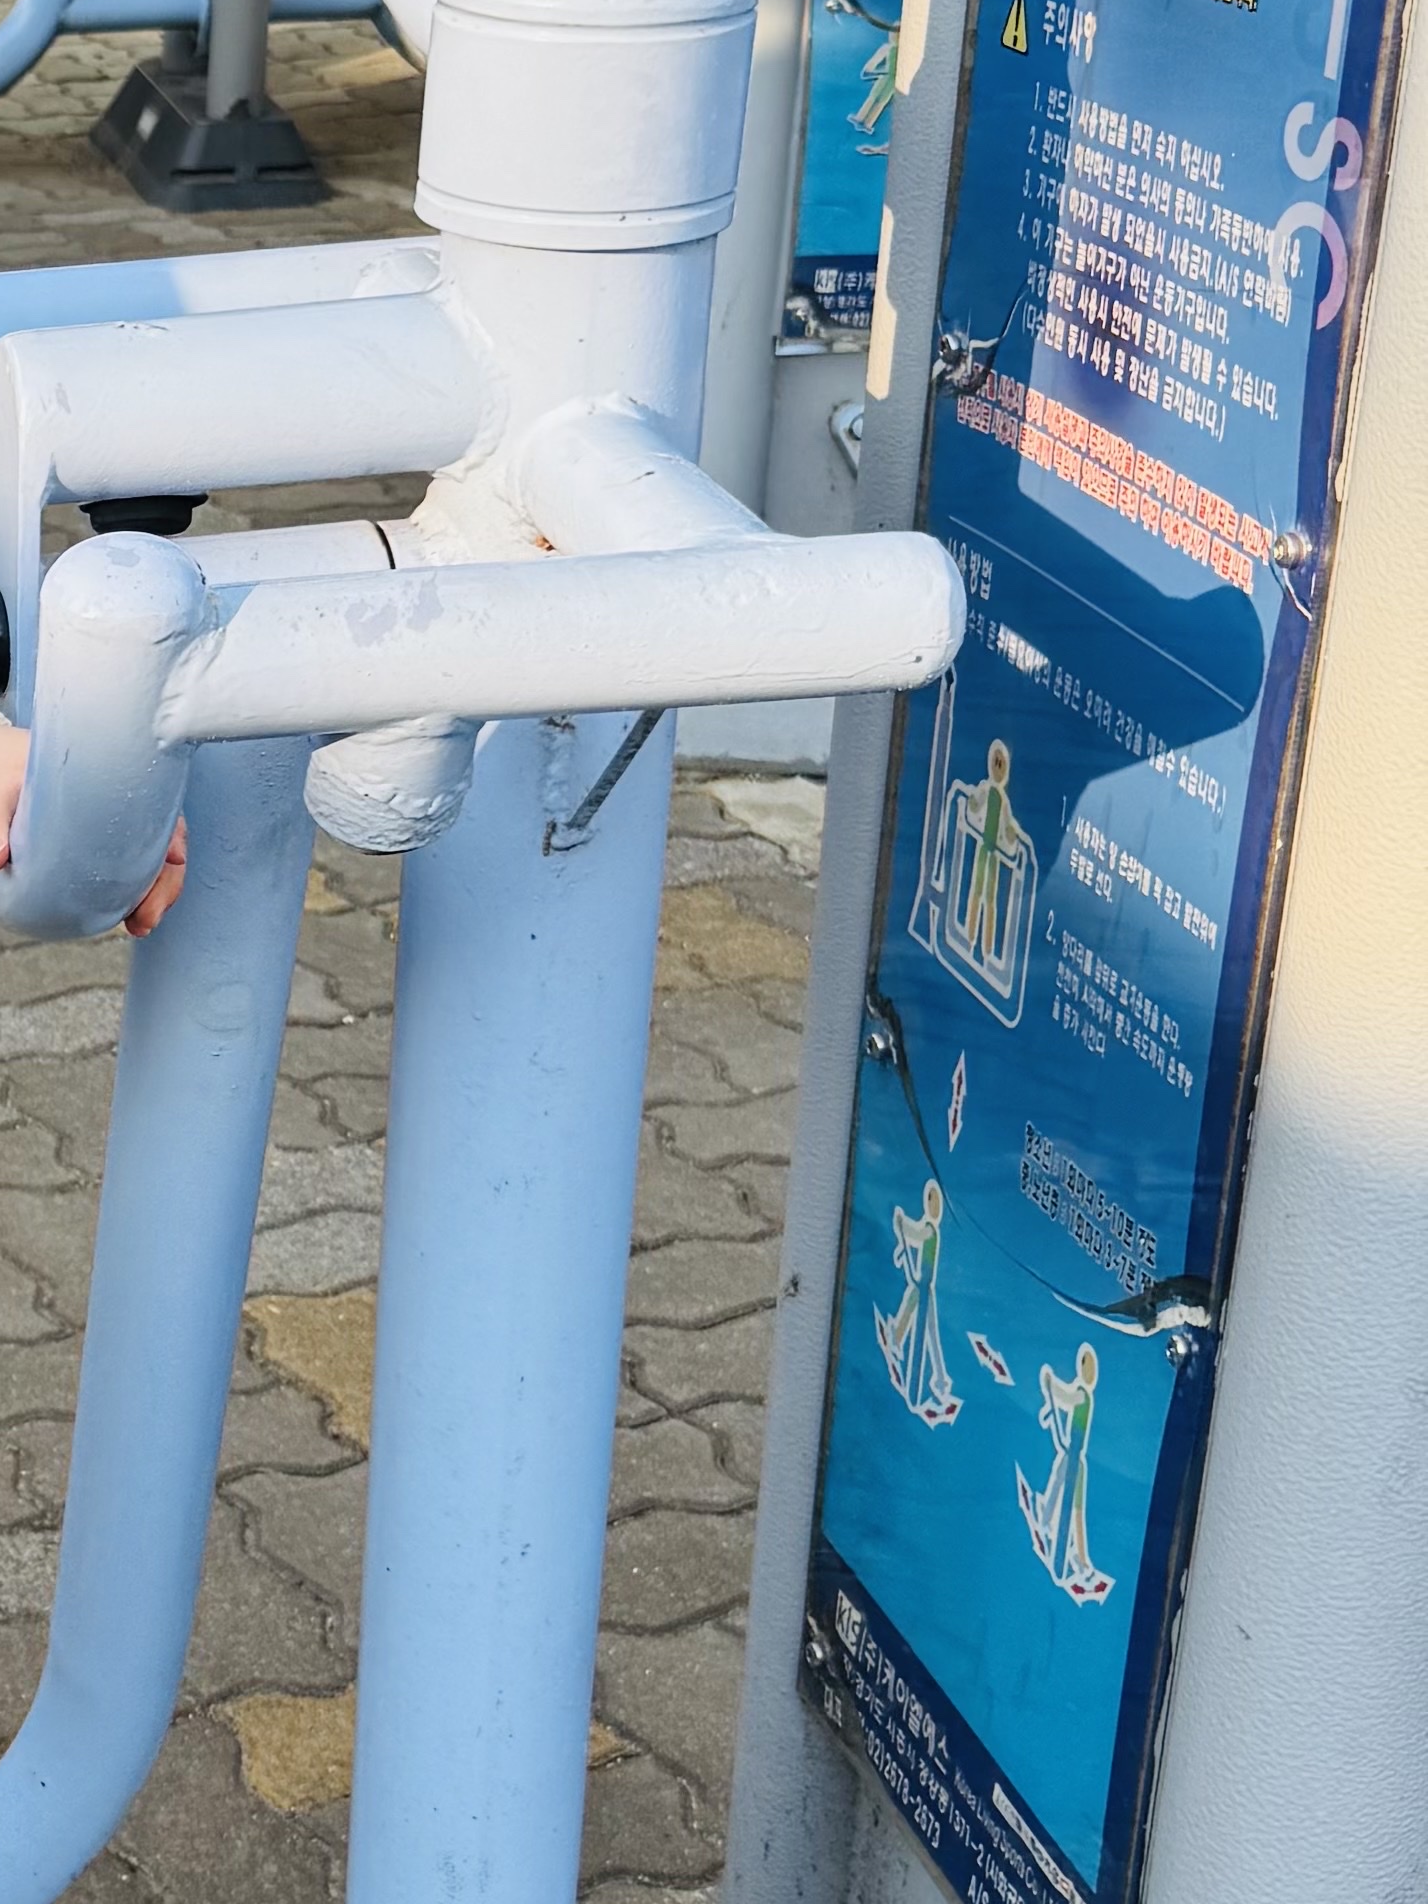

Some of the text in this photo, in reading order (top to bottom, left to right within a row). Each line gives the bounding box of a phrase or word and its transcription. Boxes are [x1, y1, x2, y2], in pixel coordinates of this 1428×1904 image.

[1043, 0, 1097, 64] 주의사항
[1027, 125, 1037, 157] 2.
[1034, 81, 1043, 112] 1.
[1046, 86, 1077, 129] 반드시
[1078, 99, 1128, 150] 사용방법을
[1131, 119, 1154, 161] 먼저
[1022, 168, 1032, 200] 3.
[1036, 172, 1067, 217] 기구에
[1017, 212, 1027, 242] 4.
[1130, 263, 1151, 304] 아닌
[1152, 272, 1230, 345] 운동기구입니다.
[1216, 358, 1228, 393] 수
[1045, 908, 1057, 947] 2.
